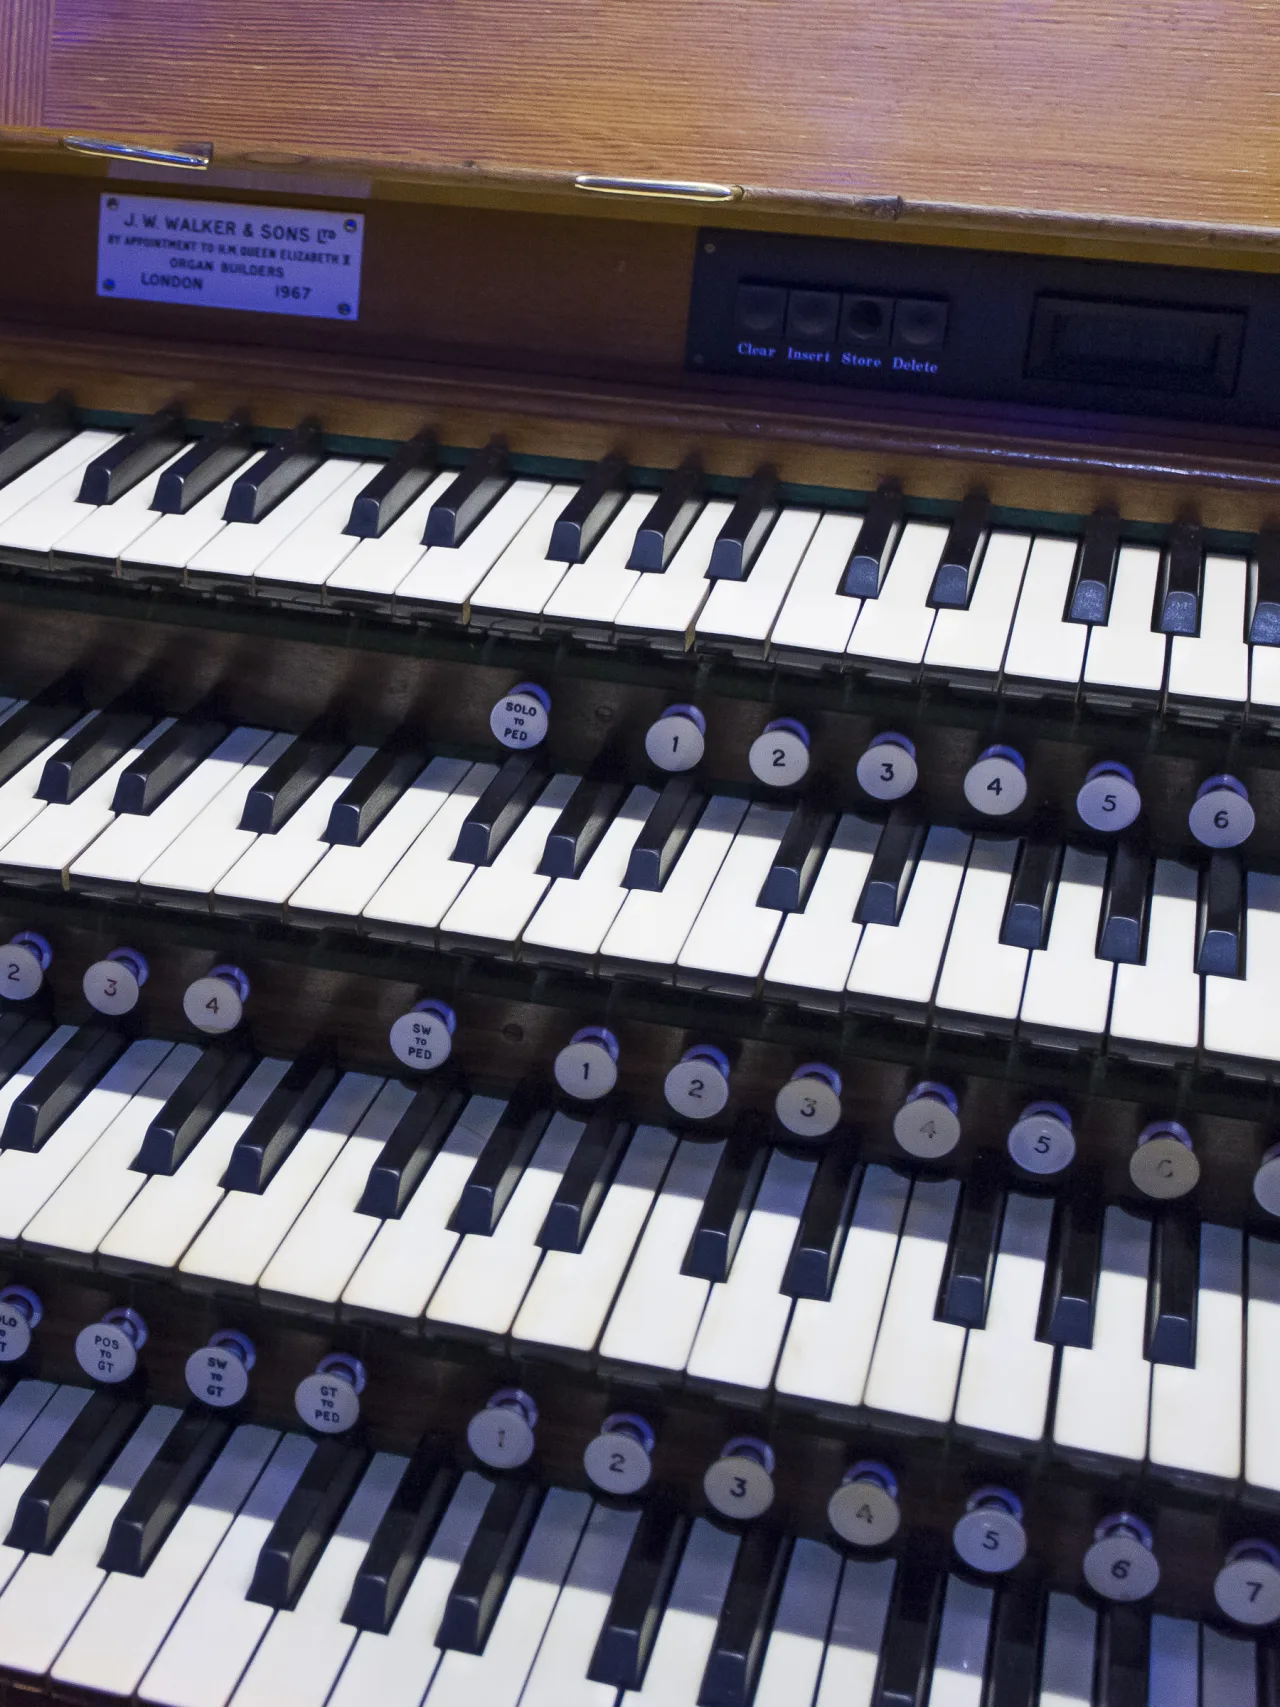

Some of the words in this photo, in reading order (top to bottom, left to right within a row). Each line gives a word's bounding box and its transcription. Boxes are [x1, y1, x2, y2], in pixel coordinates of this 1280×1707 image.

[124, 213, 138, 228] J.
[165, 215, 236, 236] WALKER
[243, 223, 254, 237] &
[260, 224, 310, 243] SONS
[108, 234, 120, 245] BY
[124, 236, 197, 251] APPOINTMENT
[201, 243, 214, 253] TO
[240, 246, 276, 259] QUEEN
[280, 249, 339, 264] ELIZABETH
[170, 257, 214, 271] ORGAN
[221, 263, 284, 278] BUILDERS
[141, 273, 203, 290] LONDON
[275, 285, 312, 300] 1967
[738, 343, 776, 358] Clear
[788, 347, 830, 363] Insert
[842, 352, 881, 368] Store
[892, 356, 938, 373] Delete
[505, 701, 537, 717] SOLO
[504, 728, 528, 741] PED
[772, 749, 786, 767] 2
[880, 763, 894, 781] 3
[987, 777, 1003, 796] 4
[1102, 794, 1116, 812] 5
[1214, 811, 1229, 829] 6
[7, 964, 20, 981] 2
[104, 979, 117, 997] 3
[206, 997, 219, 1014] 4
[412, 1023, 431, 1036] SW
[408, 1047, 432, 1060] PED
[688, 1079, 704, 1098] 2
[800, 1097, 817, 1118] 3
[1034, 1136, 1051, 1155] 5
[94, 1335, 119, 1350] POS
[97, 1359, 114, 1373] GT
[207, 1357, 227, 1371] SW
[206, 1385, 224, 1398] GT
[320, 1386, 338, 1398] GT
[314, 1410, 340, 1423] PED
[609, 1453, 625, 1473] 2
[730, 1477, 747, 1498] 3
[982, 1532, 999, 1550] 5
[1111, 1559, 1131, 1579] 6
[1246, 1582, 1263, 1603] 7
